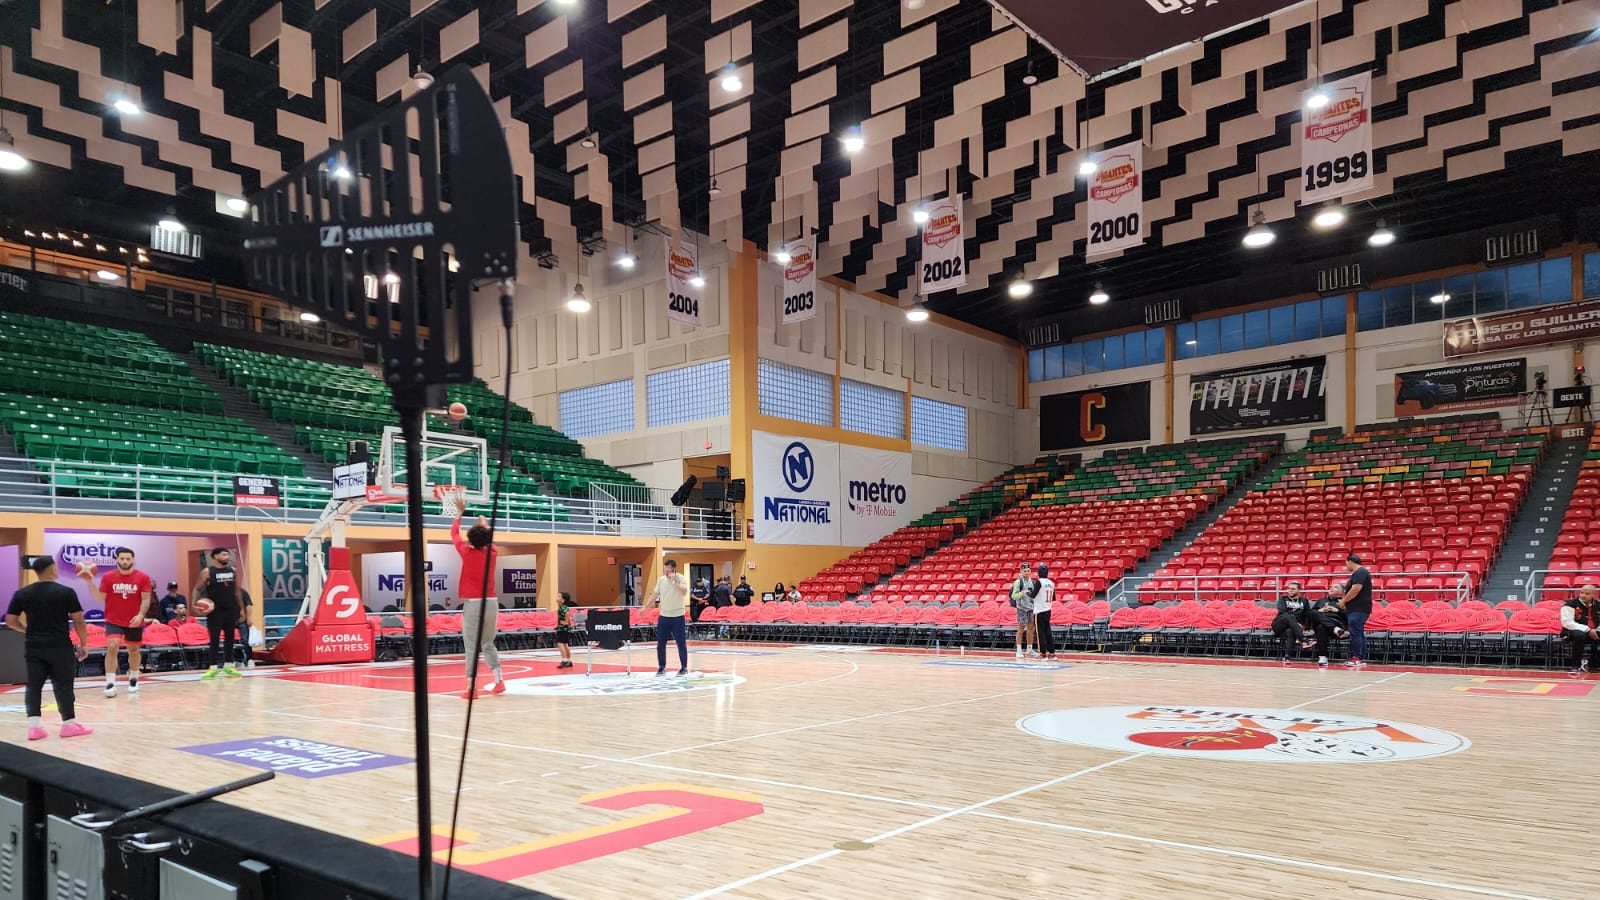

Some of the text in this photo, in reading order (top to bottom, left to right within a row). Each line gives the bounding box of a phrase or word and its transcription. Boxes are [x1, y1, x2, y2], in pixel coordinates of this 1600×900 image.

[1312, 118, 1360, 138] CAMPEONAS
[1305, 151, 1367, 191] 1999
[347, 221, 434, 241] SENNHEISER
[1090, 212, 1139, 244] 2000
[923, 256, 962, 283] 2002
[669, 292, 699, 317] 2004
[785, 291, 814, 315] 2003
[1455, 321, 1525, 338] COISEO
[1471, 335, 1502, 345] CASA
[1524, 329, 1546, 338] LOS
[1549, 321, 1600, 334] GIGANTE
[1483, 361, 1521, 370] NUESTROS
[1464, 377, 1510, 392] Pinturas
[1560, 393, 1584, 402] OESTE
[1080, 393, 1106, 442] C
[1561, 428, 1585, 439] OESTE
[849, 478, 906, 505] metro
[764, 496, 831, 524] NATIONAL
[856, 504, 865, 518] by
[874, 505, 897, 517] Mobile
[272, 549, 303, 573] DE
[271, 574, 309, 599] AQ
[511, 571, 536, 582] plane
[515, 581, 536, 590] fitne
[594, 623, 623, 631] molten
[315, 643, 369, 653] MATTRESS
[321, 634, 363, 643] GLOBAL
[215, 748, 361, 773] planet
[257, 738, 387, 763] fitness
